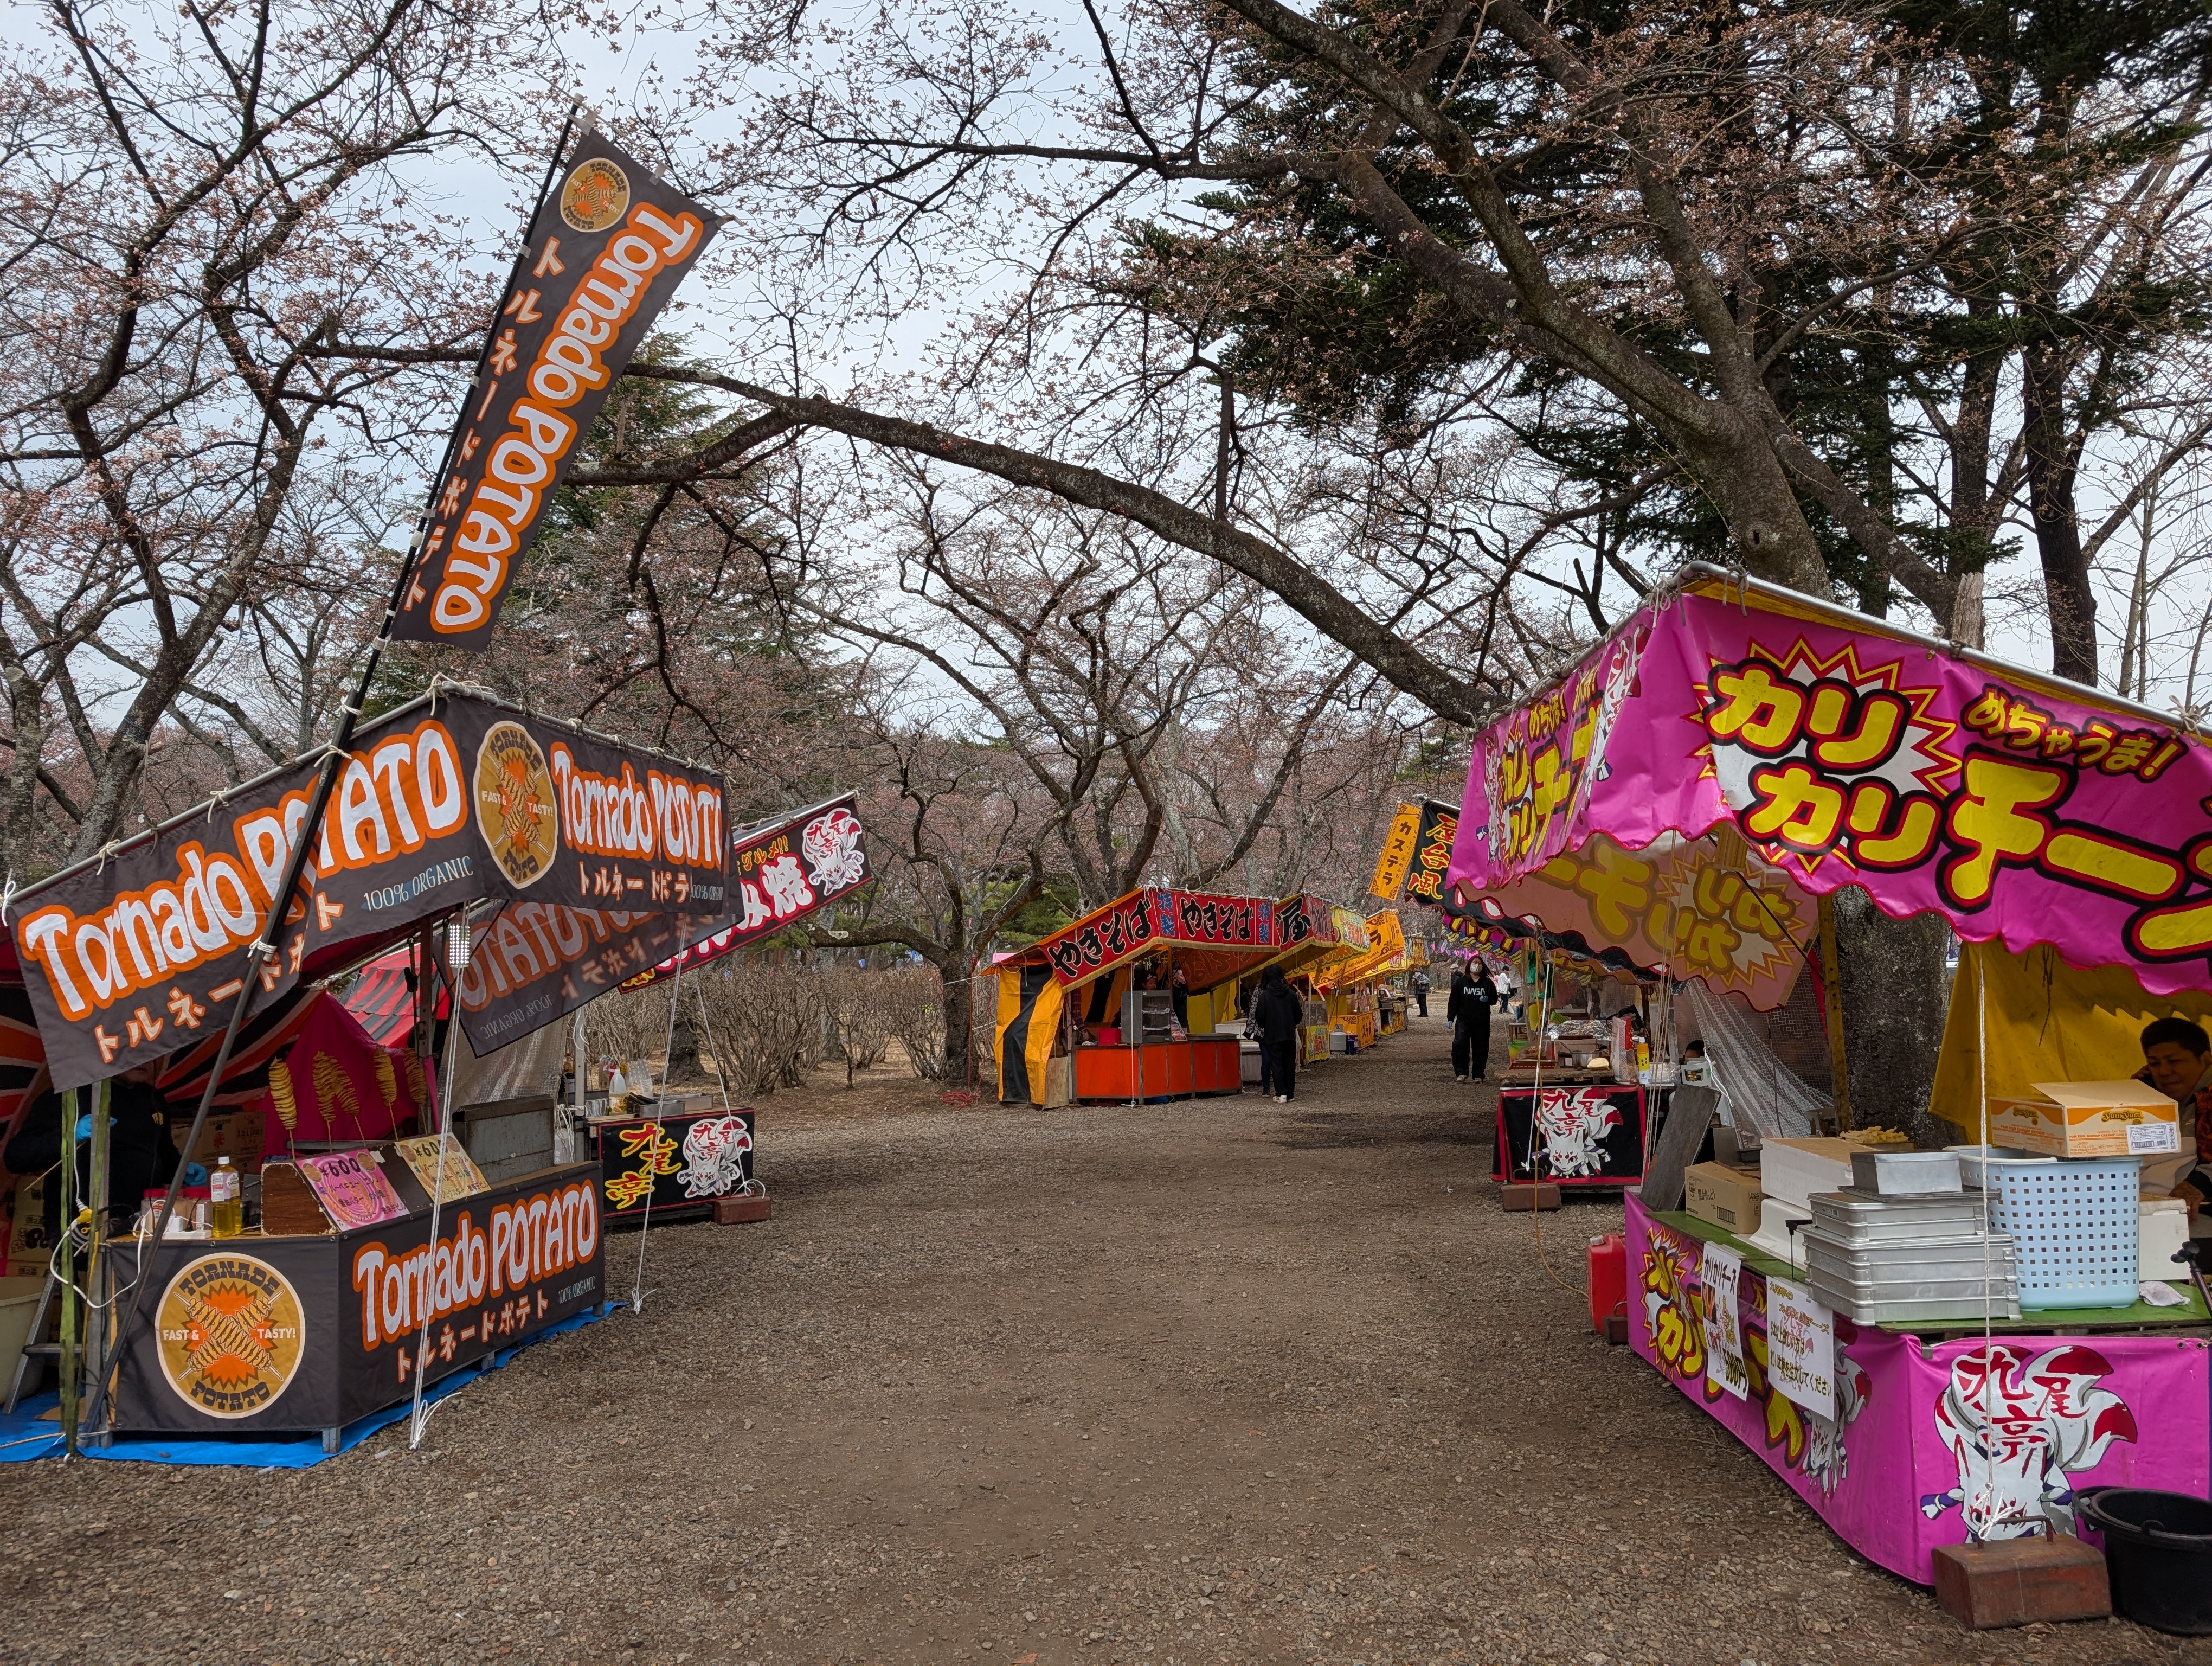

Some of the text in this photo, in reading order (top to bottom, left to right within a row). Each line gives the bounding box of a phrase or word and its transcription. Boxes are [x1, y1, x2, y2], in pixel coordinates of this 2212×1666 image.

[570, 178, 582, 189] FAST
[602, 198, 621, 215] TASTY!
[404, 235, 566, 612] トルネードポテト
[433, 209, 696, 629] Tornado POTATO
[1710, 667, 1899, 764] カリ
[1967, 689, 2182, 778] めちゃうま!
[481, 790, 507, 806] FAST &
[528, 801, 553, 817] TASTY!
[553, 749, 654, 854] Tornado
[1747, 766, 1938, 864] カリ
[1382, 821, 1412, 886] カステラ
[1408, 813, 1459, 900] 屋台風
[1950, 757, 2212, 952] チー
[363, 855, 474, 912] 100% ORGANIC
[578, 861, 692, 905] トルネードポテ
[692, 883, 708, 900] 00%
[24, 848, 258, 1013] Tornado
[1156, 891, 1176, 937] 特製
[1179, 896, 1254, 940] やきそば
[1258, 902, 1270, 944] 特製
[1276, 896, 1312, 945] 屋
[1047, 897, 1152, 978] やきそば
[1463, 986, 1486, 995] NASA
[1542, 1091, 1603, 1138] 九尾亭
[692, 1123, 735, 1162] 九尾亭
[318, 1157, 362, 1177] ¥600
[619, 1122, 682, 1210] 九尾亭
[179, 1259, 281, 1297] TORNADE
[353, 1183, 596, 1344] Tornado POTATO
[1703, 1253, 1737, 1295] カリカリチーズ
[558, 1275, 596, 1305] 100% ORGANIC
[163, 1329, 200, 1341] FAST &
[258, 1328, 297, 1340] TASTY!
[396, 1290, 550, 1383] トルネードポテト
[189, 1381, 271, 1411] POTATO
[1955, 1350, 2091, 1465] 九尾亭
